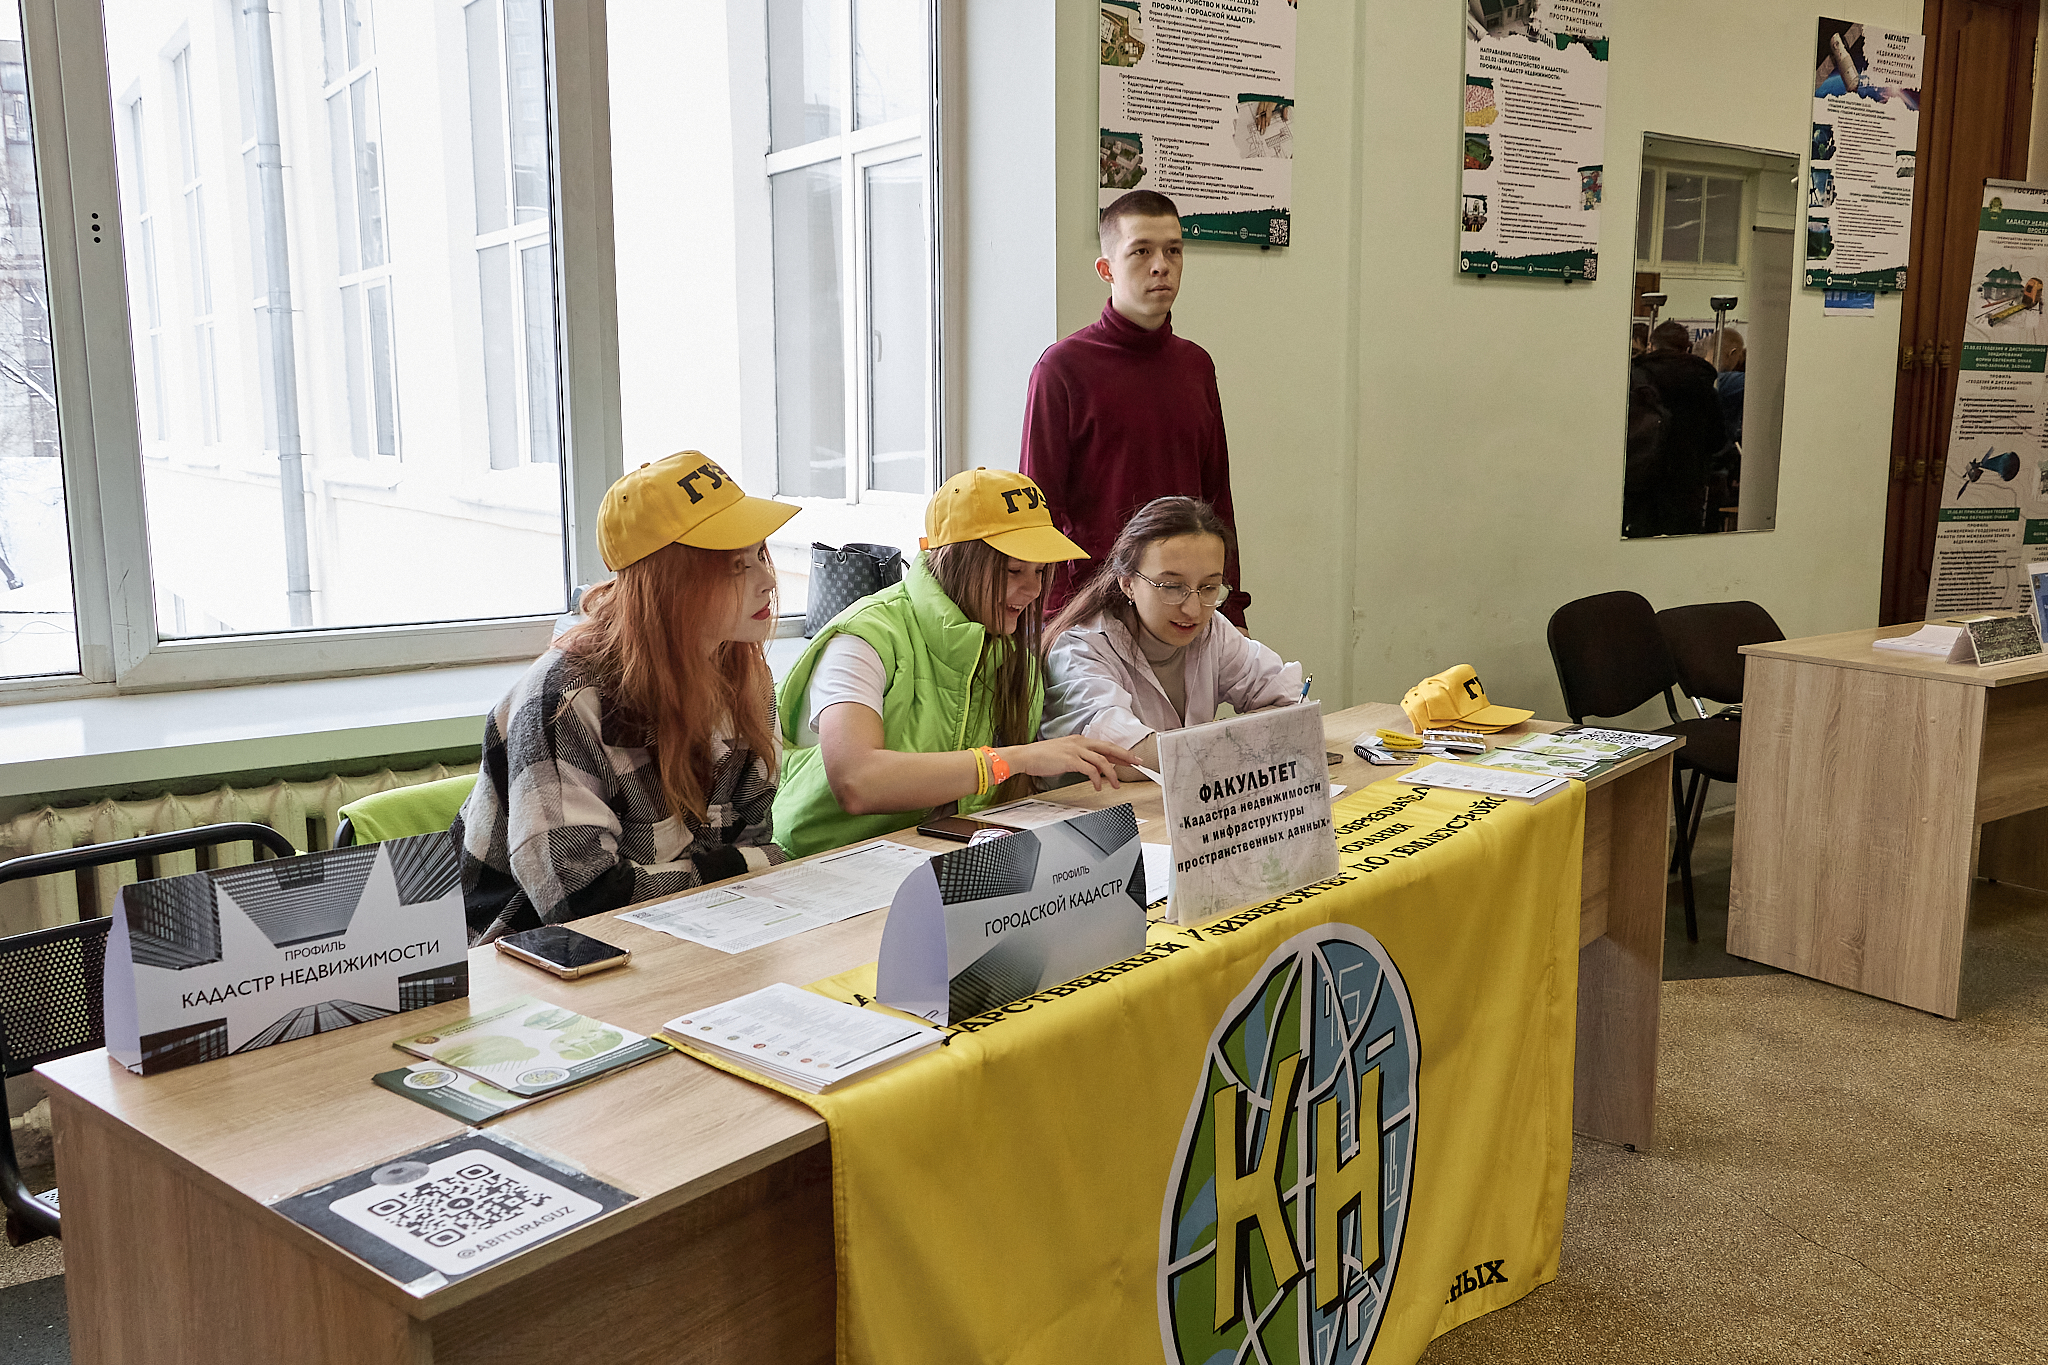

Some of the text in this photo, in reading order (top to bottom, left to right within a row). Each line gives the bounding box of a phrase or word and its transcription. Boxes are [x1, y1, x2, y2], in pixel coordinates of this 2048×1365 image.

[1199, 760, 1297, 804] ФАКУЛЬТЕТ
[1179, 782, 1321, 830] «Кадастра недвижимости
[1202, 805, 1305, 844] и инфраструктуры
[1177, 817, 1331, 873] пространственных данных»
[1347, 855, 1390, 873] ПО
[1052, 865, 1090, 885] ПРОФИЛЬ
[984, 878, 1123, 937] ГОРОДСКОЙ КАДАСТР
[285, 940, 346, 961] ПРОФИЛЬ
[182, 939, 440, 1009] КАДАСТР НЕДВИЖИМОСТИ
[457, 1205, 575, 1259] @ABITURAGUZ
[1444, 1259, 1509, 1305] НЫХ
